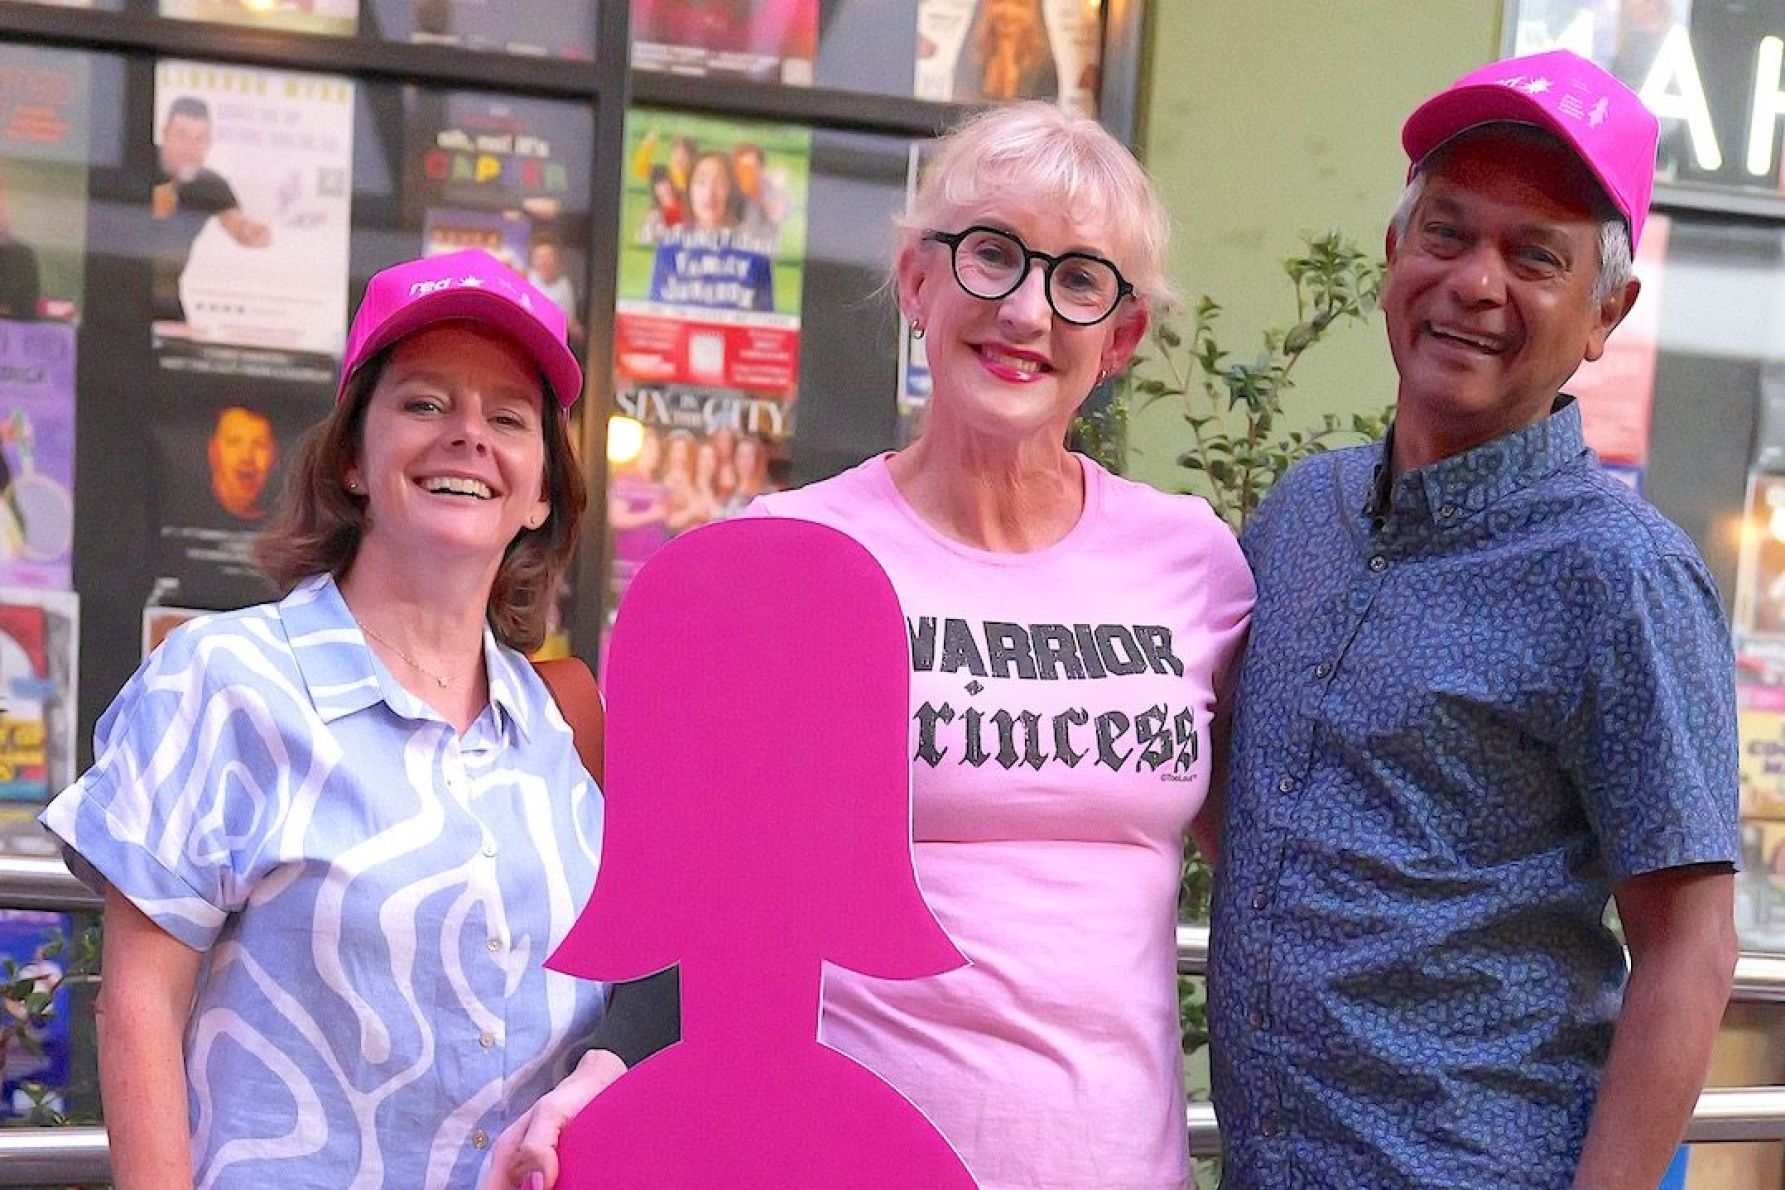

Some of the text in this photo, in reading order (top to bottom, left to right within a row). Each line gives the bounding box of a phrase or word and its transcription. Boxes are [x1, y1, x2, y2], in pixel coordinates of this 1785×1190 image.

[615, 387, 672, 425] SIX
[702, 396, 789, 435] CITY
[912, 680, 1198, 773] rincess
